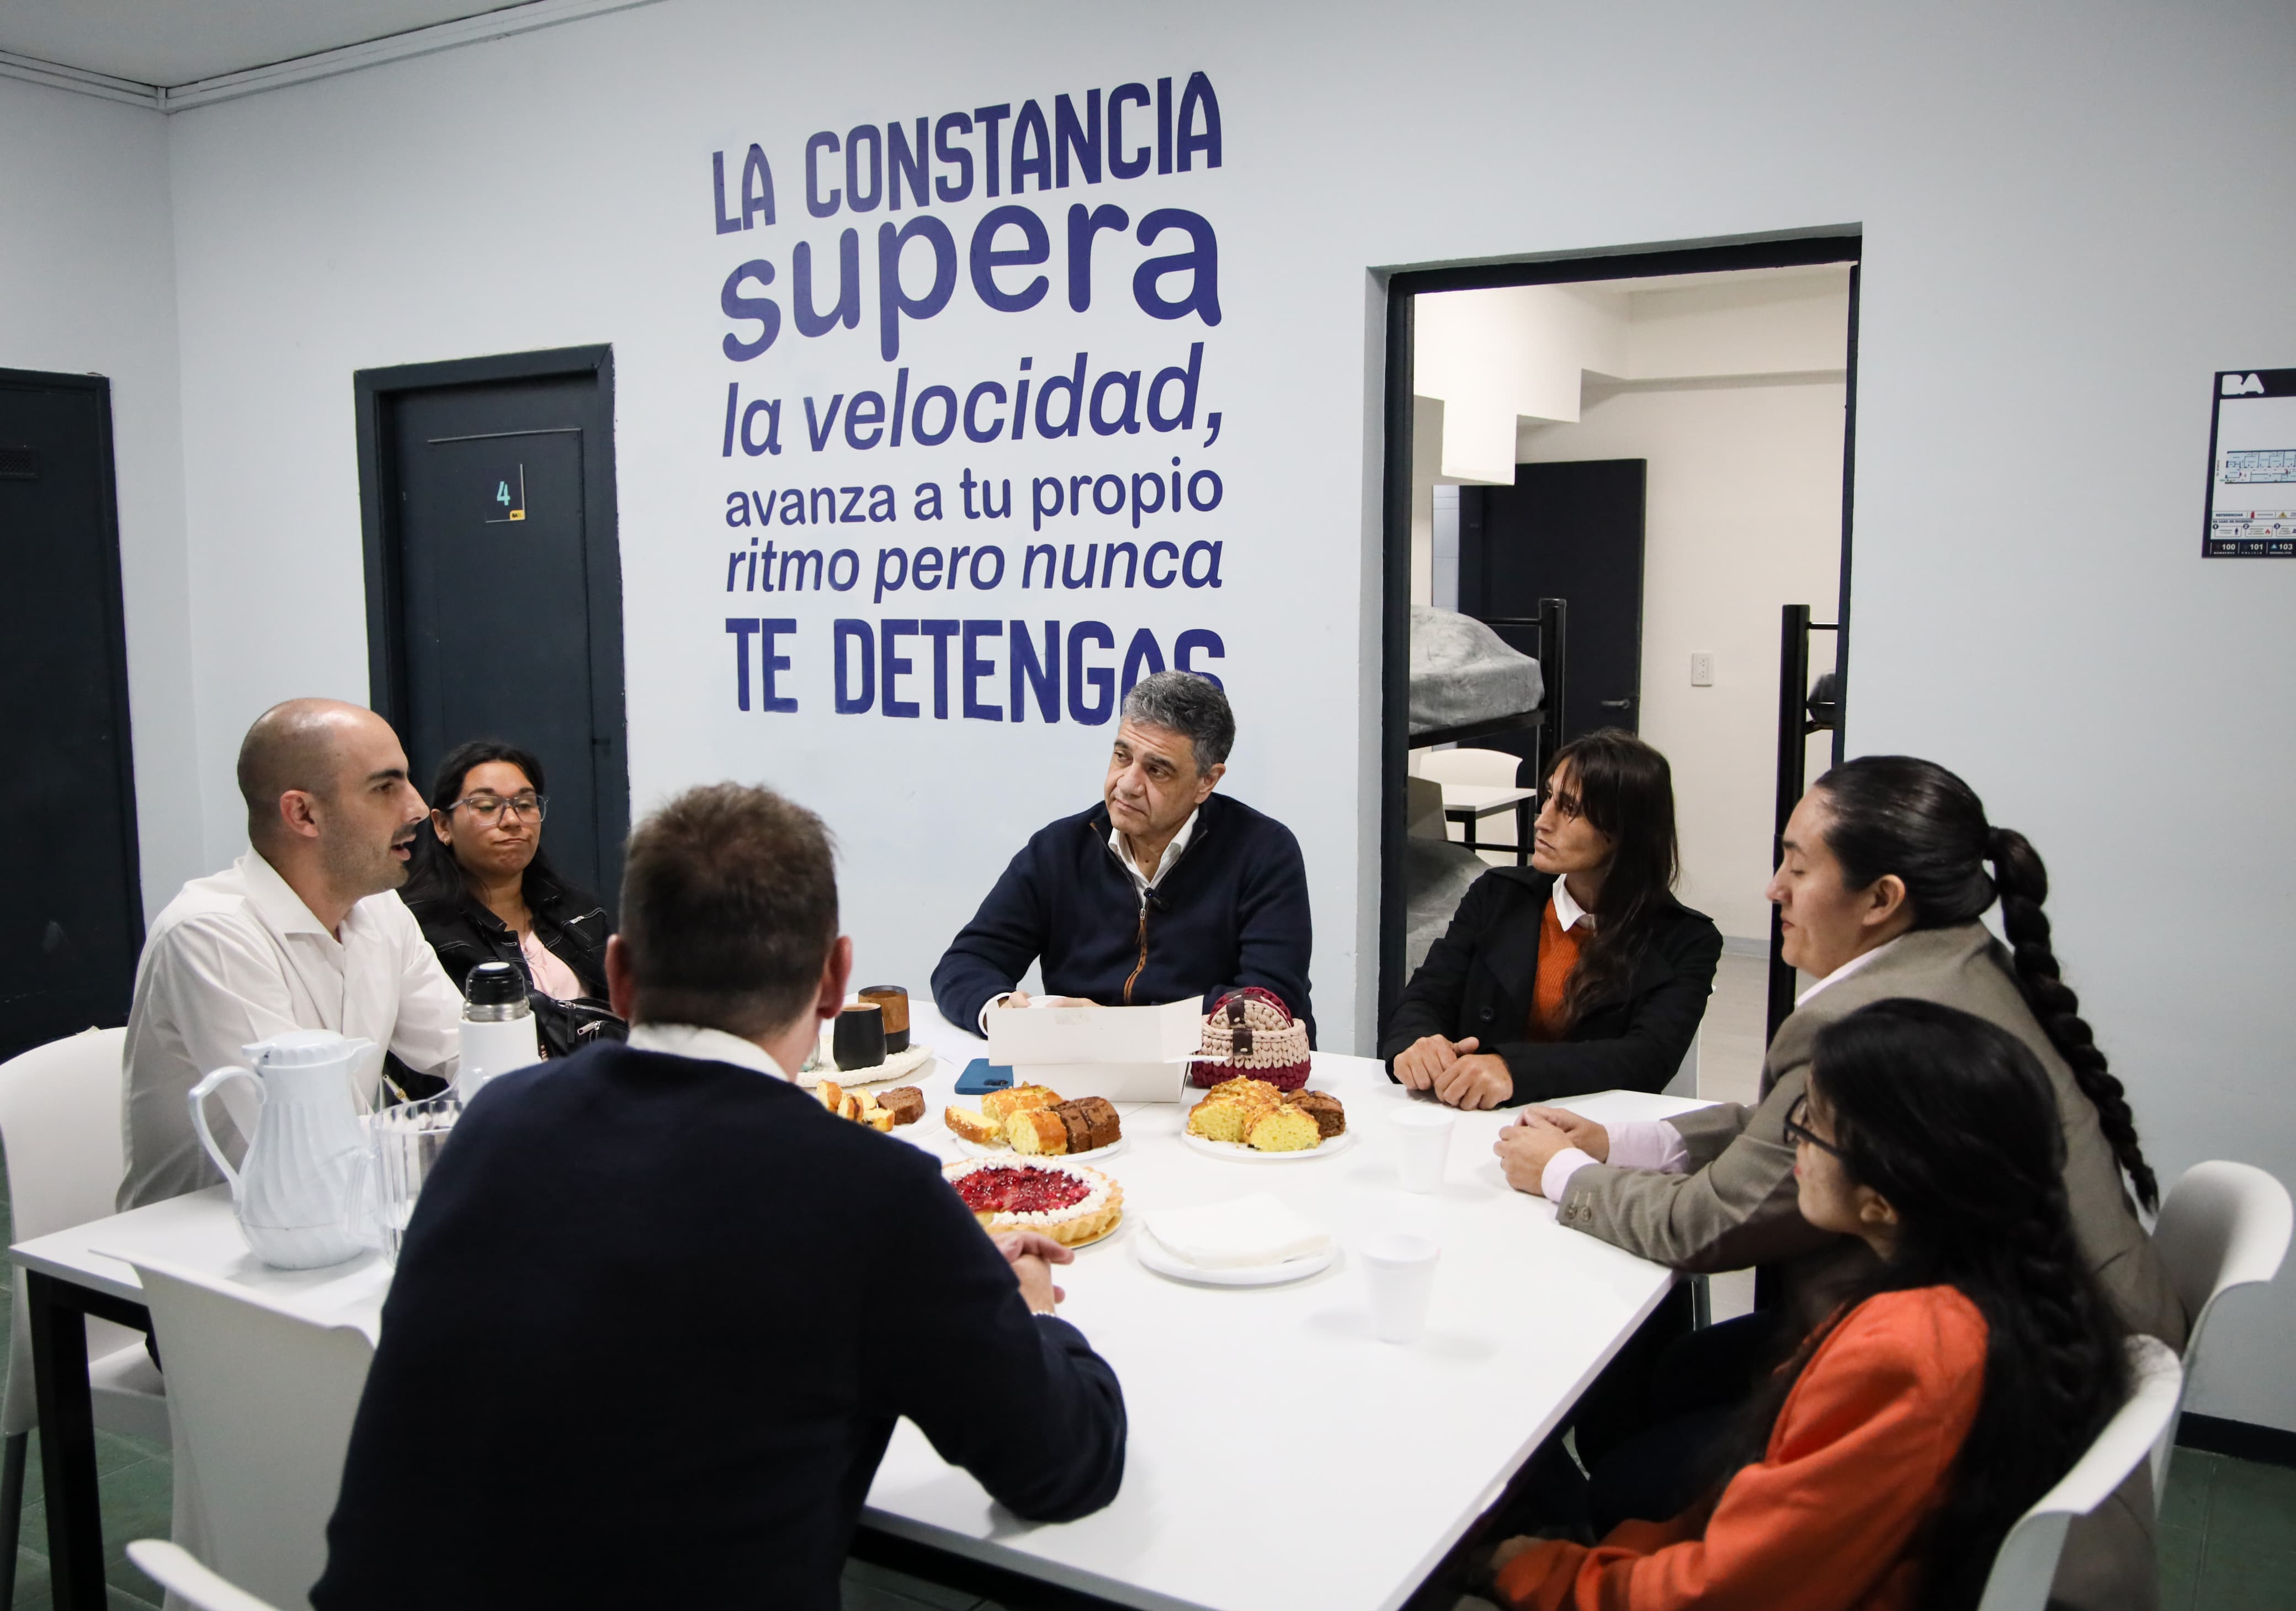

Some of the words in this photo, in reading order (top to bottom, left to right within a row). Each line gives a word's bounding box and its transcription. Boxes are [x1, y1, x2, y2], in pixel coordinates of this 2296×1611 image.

[713, 143, 775, 235] LA
[806, 71, 1221, 218] CONSTANCIA
[721, 203, 1221, 362] supera
[722, 383, 782, 457] la
[804, 342, 1222, 452] velocidad,
[497, 481, 511, 506] 4
[726, 485, 896, 527] avanza
[915, 483, 943, 521] a
[960, 468, 1011, 519] tu
[1033, 457, 1223, 531] propio
[727, 537, 859, 592] ritmo
[874, 545, 1005, 603] pero
[1022, 540, 1223, 589] nunca
[726, 618, 798, 713] TE
